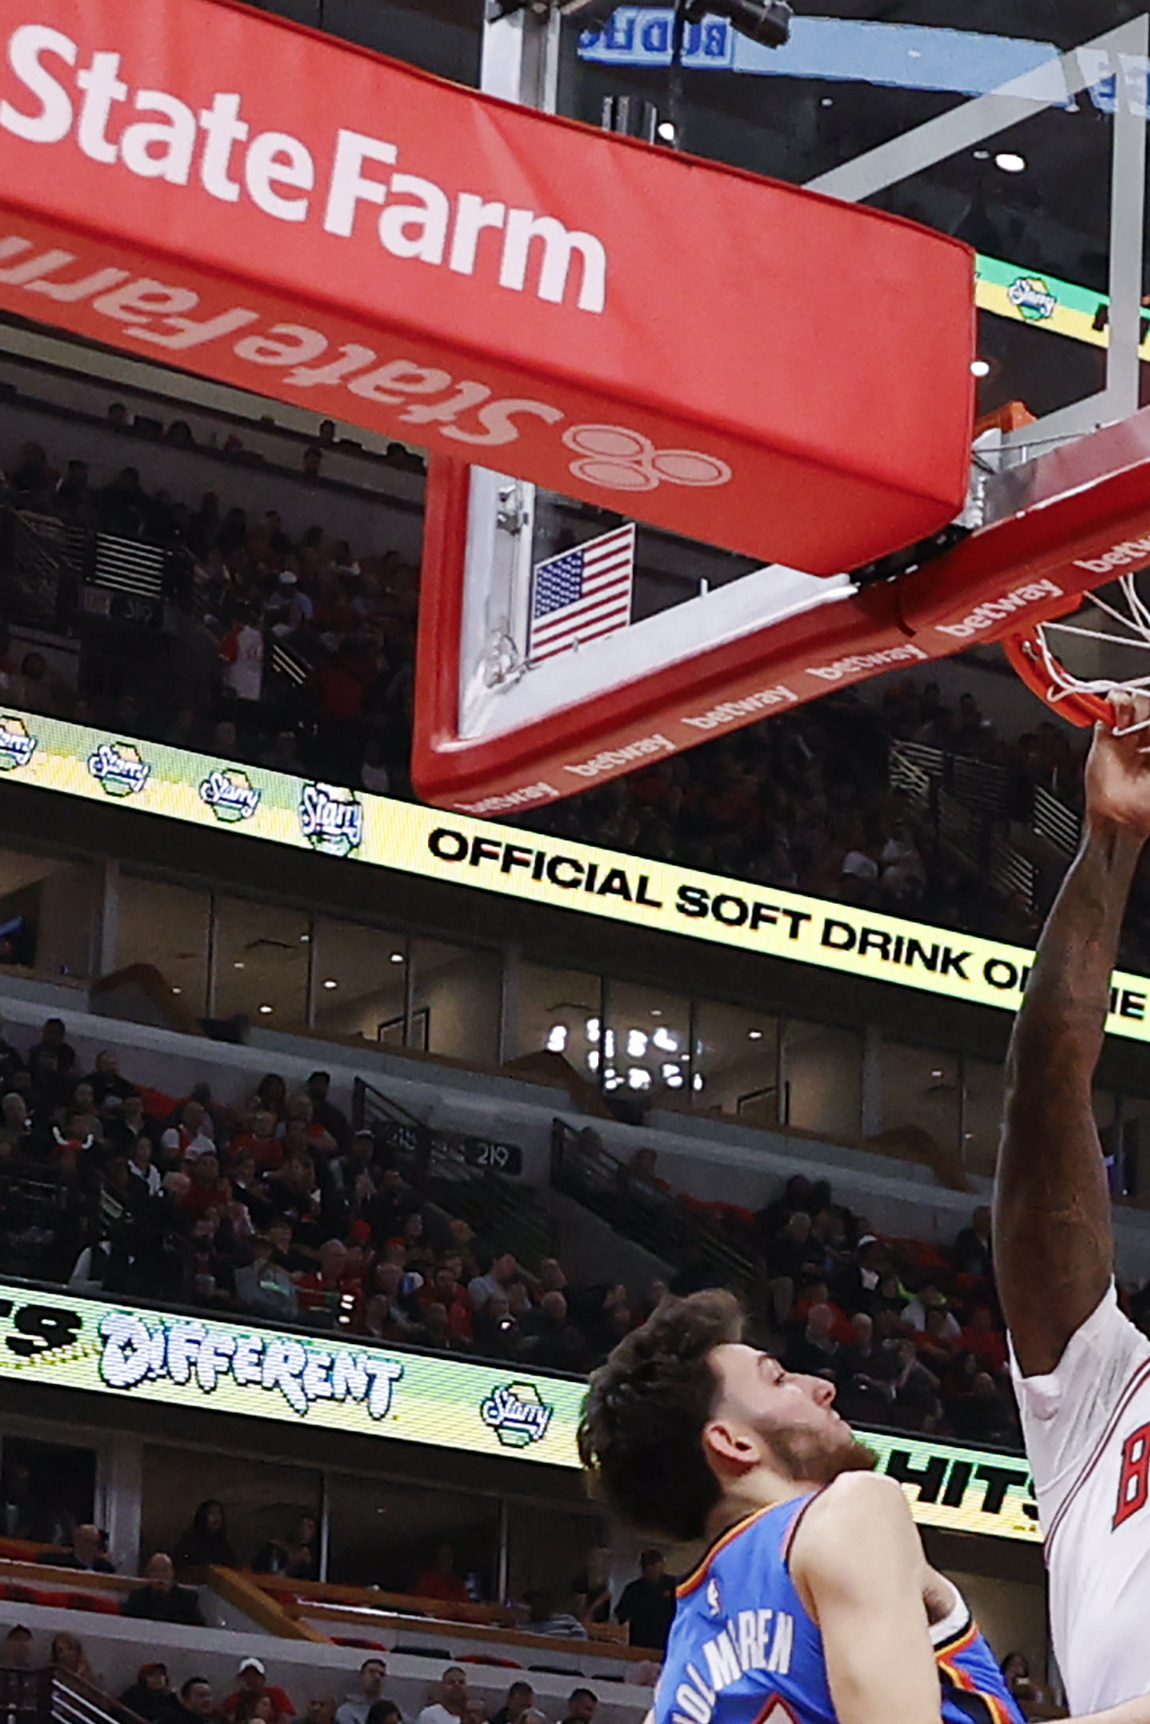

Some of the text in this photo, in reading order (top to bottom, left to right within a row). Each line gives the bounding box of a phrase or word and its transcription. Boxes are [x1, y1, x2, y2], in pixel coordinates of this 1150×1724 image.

[935, 578, 1063, 638] betway
[805, 631, 928, 682] betway
[682, 682, 798, 729] betway
[564, 730, 676, 778] betway
[428, 826, 664, 908] OFFICIAL
[676, 884, 811, 940] SOFT
[820, 918, 974, 981] DRINK
[100, 1311, 404, 1420] DIFFERENT
[885, 1449, 1040, 1521] HIT
